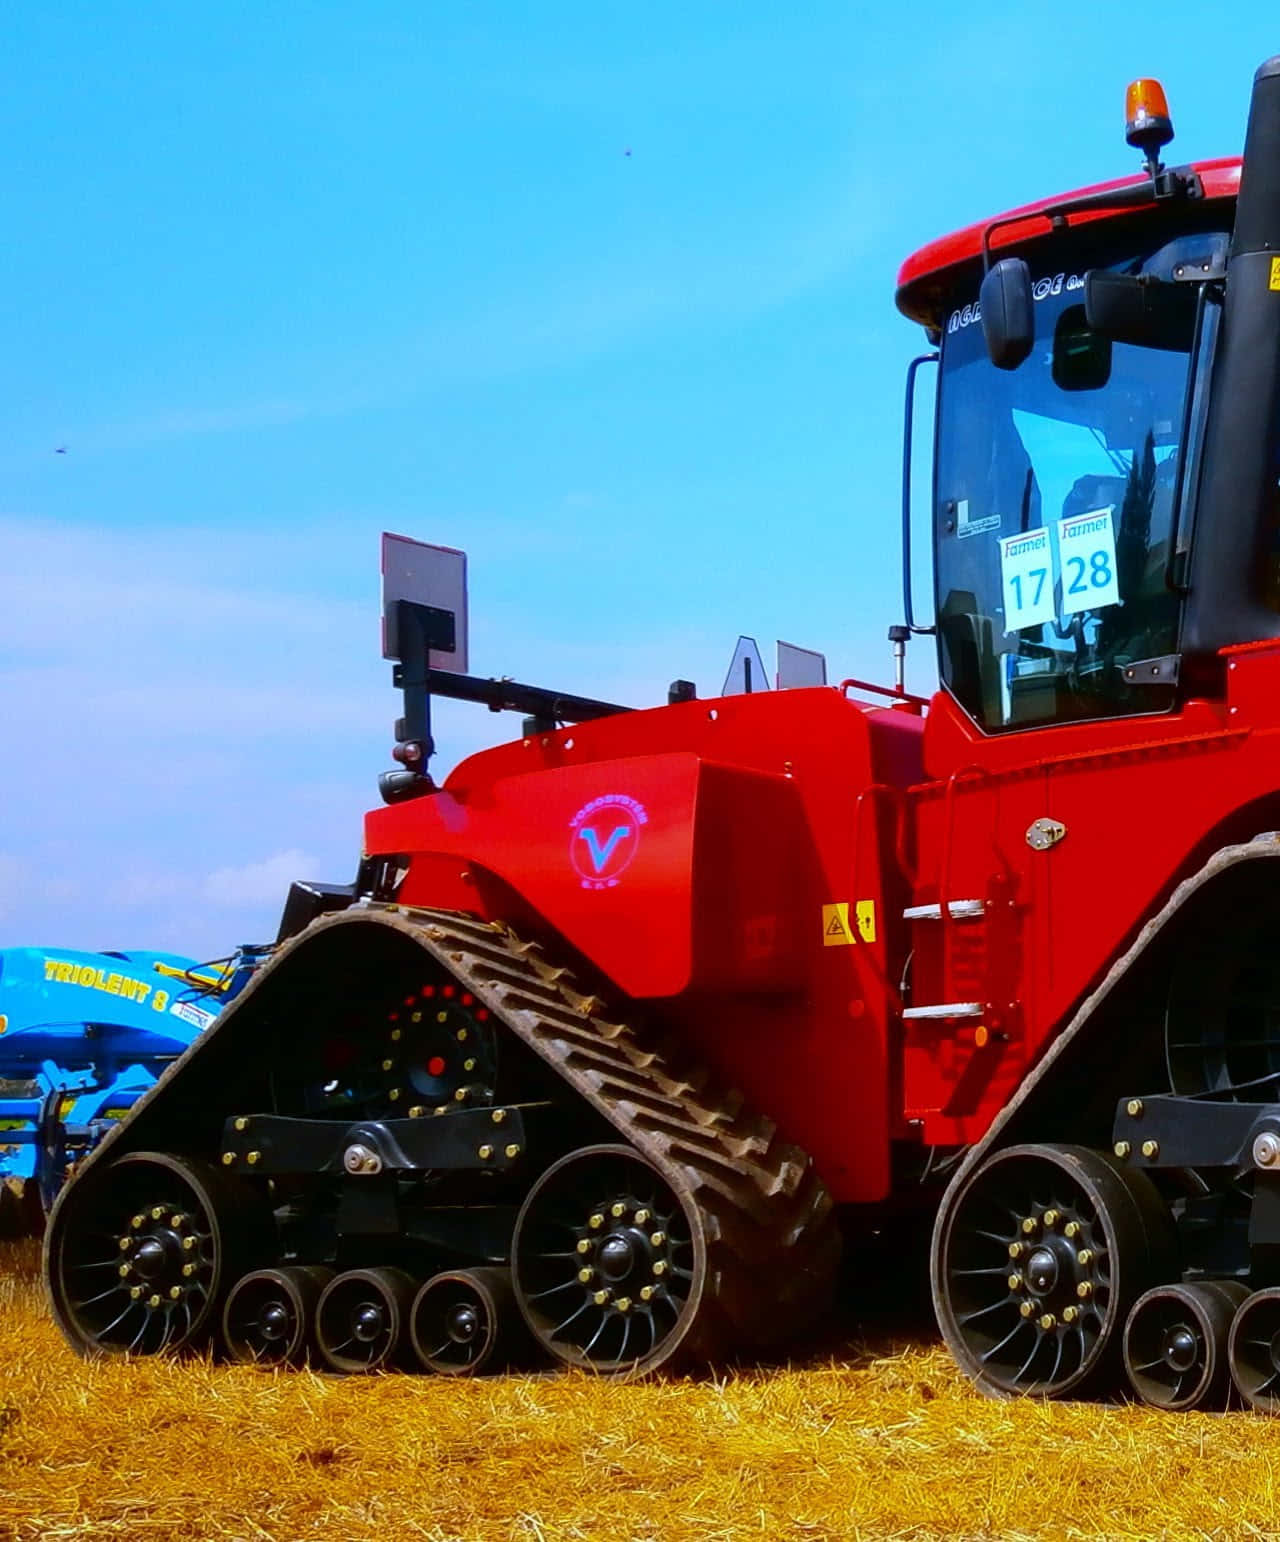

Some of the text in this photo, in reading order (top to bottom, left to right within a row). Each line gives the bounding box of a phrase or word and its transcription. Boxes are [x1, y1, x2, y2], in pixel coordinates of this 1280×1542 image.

[1005, 532, 1046, 558] Farmet
[1062, 513, 1108, 540] Farmet
[1009, 567, 1048, 610] 17
[1066, 550, 1112, 594] 28
[44, 960, 170, 1013] TRIOLENT 8
